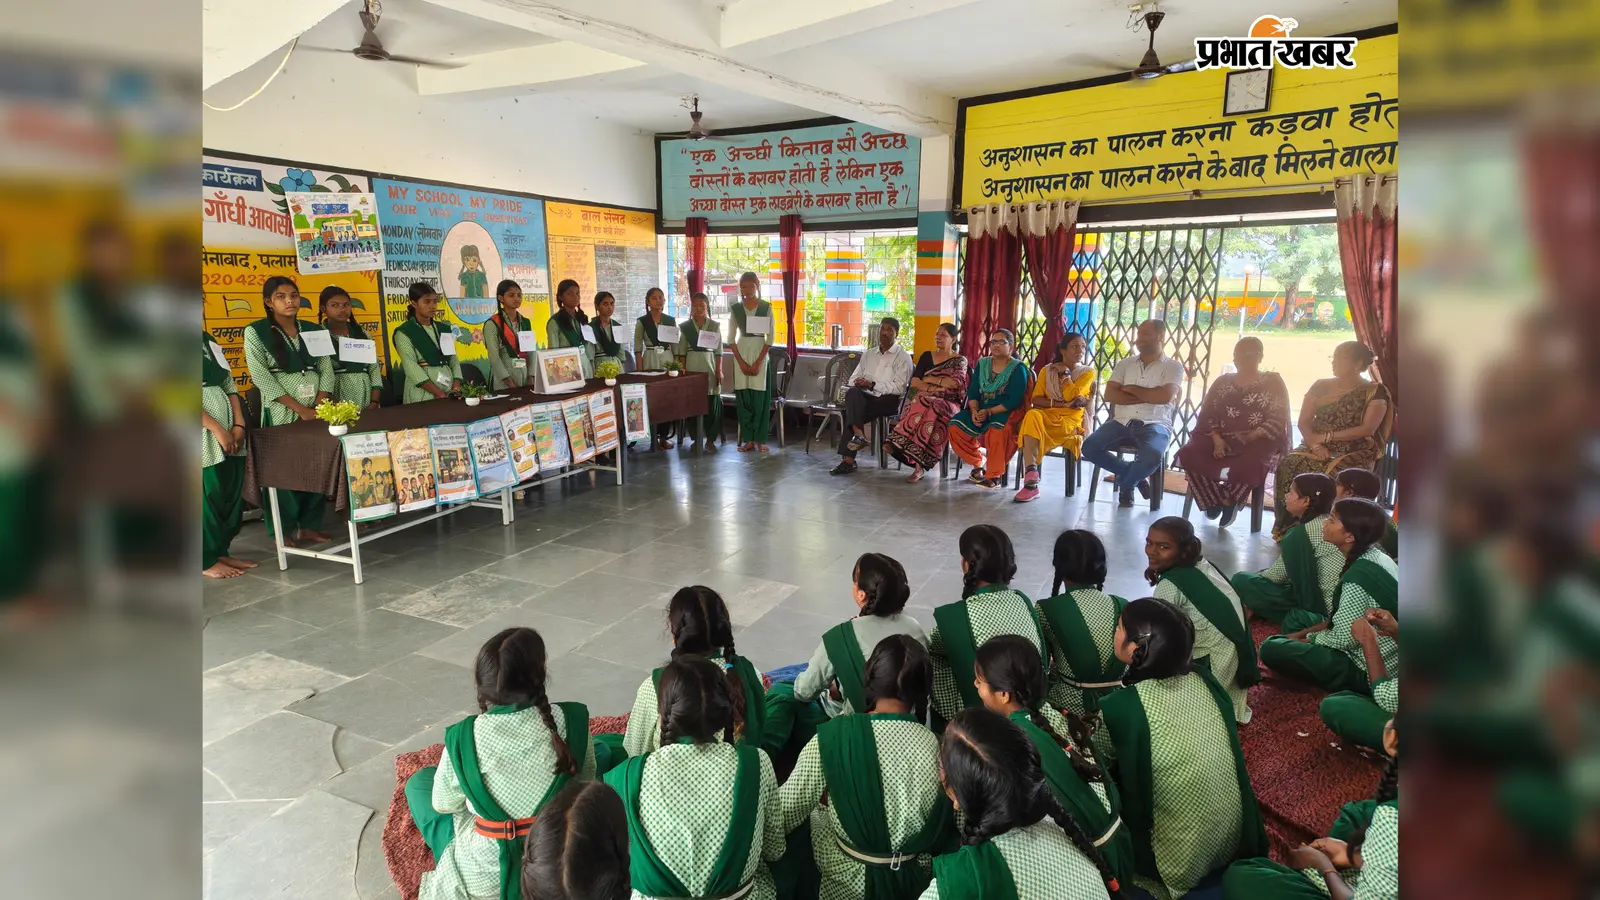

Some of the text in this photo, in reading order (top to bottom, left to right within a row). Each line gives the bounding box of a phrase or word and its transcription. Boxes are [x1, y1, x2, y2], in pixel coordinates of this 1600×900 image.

[725, 139, 772, 162] अच्छी
[778, 136, 833, 160] किताब
[979, 141, 1067, 172] अनुशासन
[1069, 138, 1099, 157] का
[1107, 130, 1167, 157] पालन
[1171, 121, 1237, 148] करना
[1247, 107, 1339, 142] कड़वा
[202, 167, 258, 188] कार्यक्रम
[732, 166, 746, 188] के
[748, 170, 787, 189] बराबर
[789, 161, 816, 189] होती
[819, 158, 833, 188] है
[835, 158, 876, 188] लेकिन
[879, 160, 904, 183] एक
[980, 172, 1070, 203] अनुशासन
[1069, 171, 1095, 191] का
[1099, 165, 1155, 192] पालन
[1156, 153, 1204, 189] करने
[1274, 139, 1340, 181] मिलने
[1339, 141, 1398, 174] वाला
[388, 185, 522, 213] MY SCHOOL MY PRIDE
[392, 204, 417, 216] OUR
[688, 197, 717, 213] अच्छा
[719, 193, 747, 213] दोस्त
[749, 197, 767, 214] एक
[802, 190, 814, 209] के
[815, 192, 851, 212] बराबर
[855, 185, 885, 213] होता
[204, 190, 295, 238] गाँधी आवासी
[380, 224, 414, 240] MONDAY
[387, 293, 410, 305] FRIDA
[387, 310, 408, 323] SATUR
